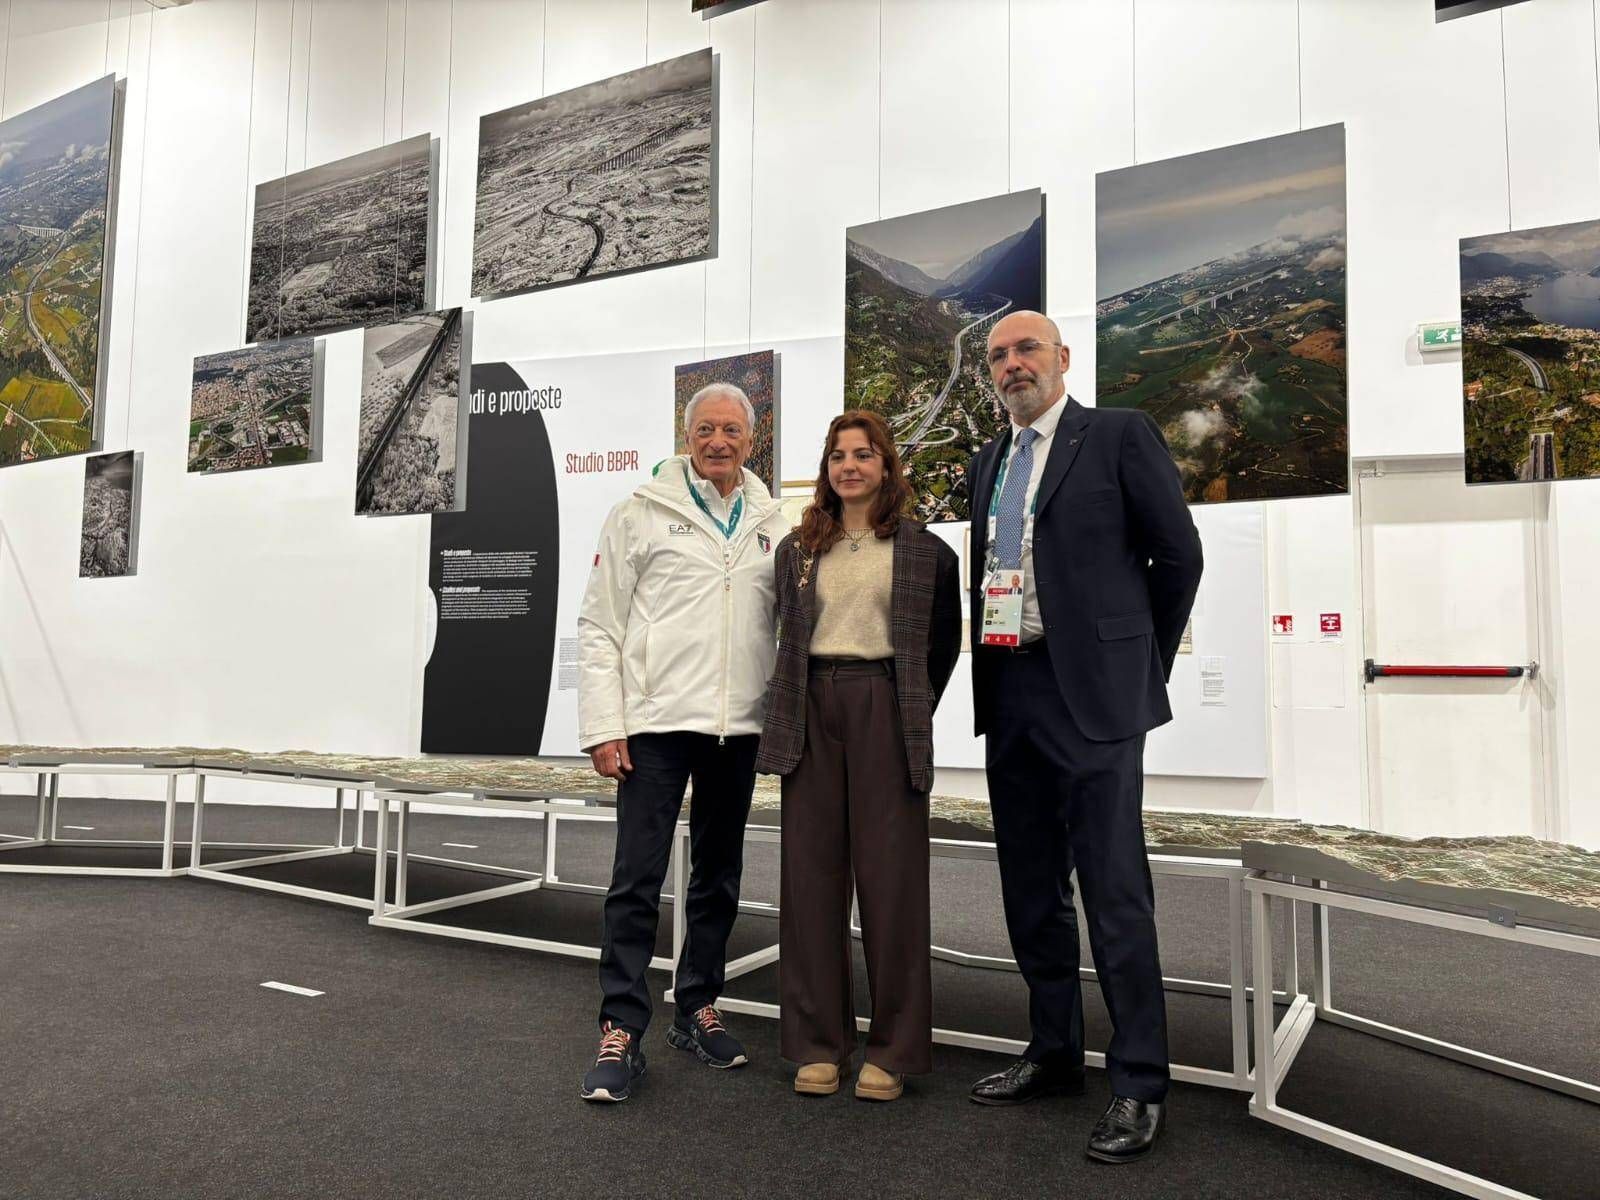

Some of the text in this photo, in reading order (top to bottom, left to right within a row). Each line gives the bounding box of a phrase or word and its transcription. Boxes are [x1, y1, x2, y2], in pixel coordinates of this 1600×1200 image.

[488, 391, 497, 413] e
[500, 385, 562, 416] proposte
[566, 450, 639, 474] Studio BBPR
